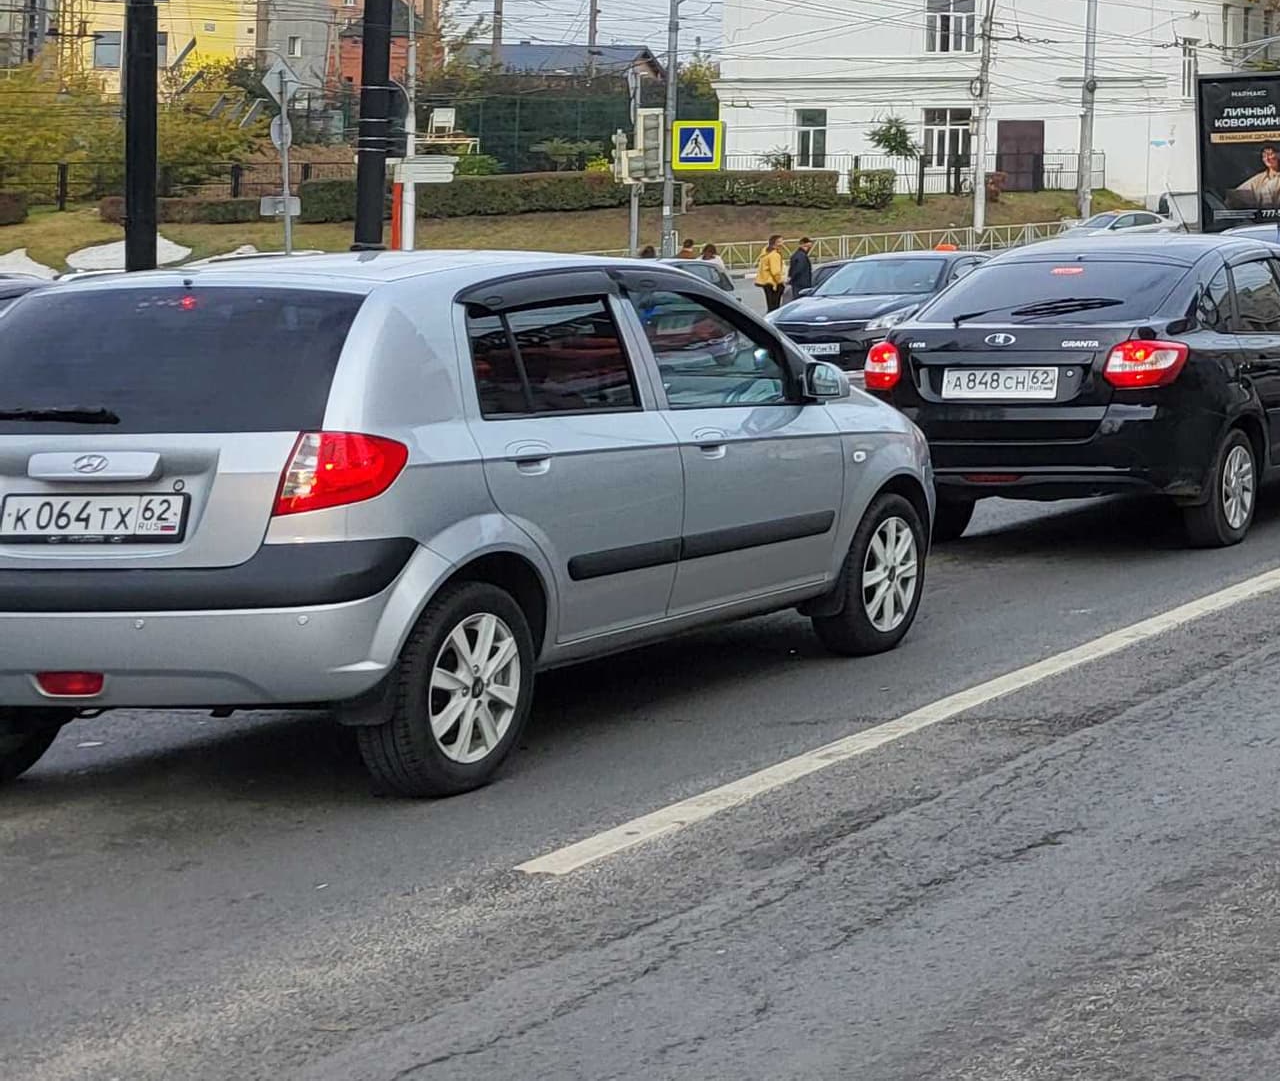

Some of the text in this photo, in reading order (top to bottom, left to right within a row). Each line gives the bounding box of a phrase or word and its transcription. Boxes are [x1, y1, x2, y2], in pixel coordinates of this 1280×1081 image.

[1222, 104, 1276, 117] ЛИЧНЫЙ
[1061, 340, 1099, 348] GRANTA
[1031, 370, 1050, 385] 62
[142, 499, 172, 522] 62
[138, 522, 160, 531] RUS
